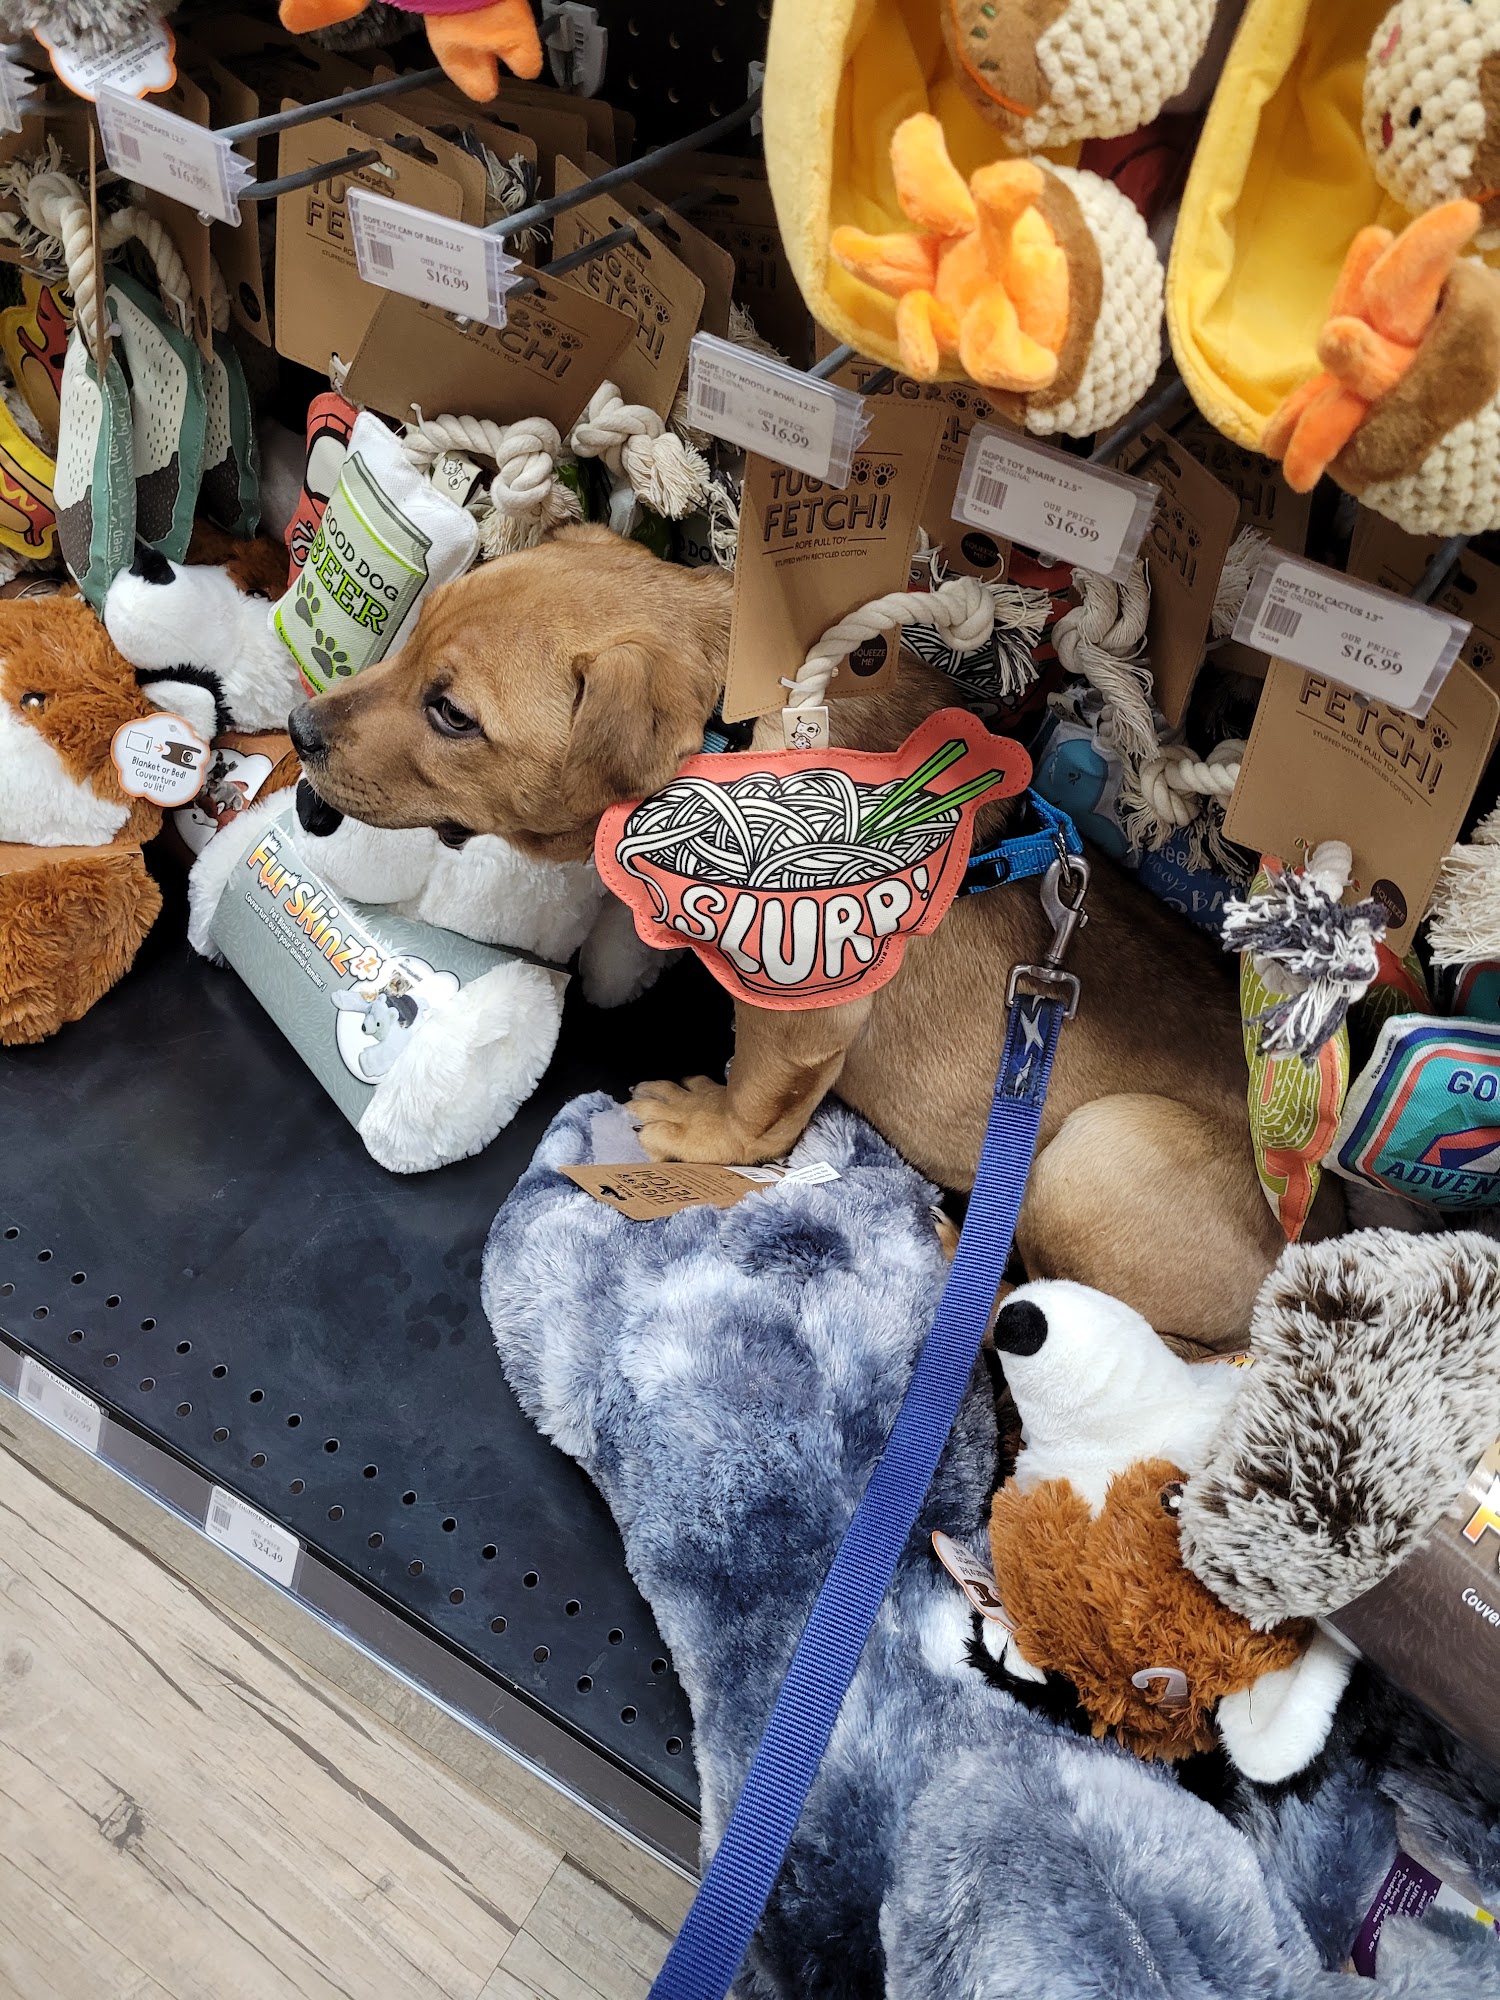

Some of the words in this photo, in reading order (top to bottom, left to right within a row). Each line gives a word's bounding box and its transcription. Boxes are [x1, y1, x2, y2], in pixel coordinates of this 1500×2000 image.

[363, 215, 381, 227] ROPE
[382, 221, 397, 231] TOY
[399, 226, 413, 238] CAN
[415, 232, 424, 240] OF
[425, 235, 444, 247] BEER
[420, 257, 435, 269] OUR
[439, 263, 463, 277] PRICE
[426, 268, 469, 292] $16.99
[503, 353, 520, 365] TOY
[699, 359, 719, 374] ROPE
[722, 368, 737, 379] TOY
[739, 376, 771, 394] NOODLE
[773, 390, 796, 405] BOWL
[758, 408, 774, 420] OUR
[778, 417, 805, 433] PRICE
[761, 420, 809, 449] $16.99
[979, 458, 994, 470] ORE
[996, 464, 1031, 483] ORIGINAL
[981, 450, 1004, 465] ROPE
[1006, 457, 1024, 470] TOY
[1026, 465, 1056, 484] SHARK
[1058, 479, 1083, 492] 12.5"
[763, 494, 891, 541] FETCH!
[1043, 501, 1062, 514] OUR
[1066, 510, 1097, 526] PRICE
[1044, 514, 1100, 542] $16.99
[325, 505, 355, 562] GOOD
[355, 558, 399, 602] DOG
[795, 539, 813, 551] ROPE
[813, 537, 832, 548] PULL
[832, 536, 848, 546] TOY
[796, 555, 811, 565] WITH
[811, 551, 840, 561] RECYCLED
[840, 549, 868, 557] COTTON
[310, 527, 389, 636] BEER
[1272, 586, 1288, 598] ORE
[1290, 592, 1329, 613] ORIGINAL
[1275, 578, 1302, 593] ROPE
[1304, 586, 1324, 600] TOY
[1324, 595, 1364, 616] CACTUS
[1364, 610, 1384, 623] 13"
[1341, 631, 1362, 645] OUR
[1366, 641, 1401, 659] PRICE
[861, 657, 875, 667] ME!
[1341, 644, 1403, 675] $16.99
[1299, 671, 1443, 794] FETCH!
[1313, 729, 1341, 748] STUFFED
[1341, 745, 1359, 760] WITH
[1359, 756, 1389, 783] RECYCLED
[1389, 780, 1414, 805] COTTON
[1341, 731, 1363, 748] ROPE
[1364, 745, 1382, 764] PULL
[1384, 758, 1399, 776] TOY
[132, 756, 161, 773] Blanket
[161, 766, 171, 775] or
[171, 767, 187, 780] Bed!
[135, 768, 177, 787] Couverture
[143, 781, 153, 789] ou
[154, 783, 165, 793] lit!
[269, 906, 280, 920] Pet
[277, 915, 296, 942] Blanket
[293, 937, 302, 946] or
[299, 943, 312, 959] Bed!
[673, 863, 929, 985] SLURP!
[244, 891, 270, 925] Couverture
[267, 920, 275, 931] ou
[273, 926, 282, 938] lit
[278, 932, 292, 952] pour
[289, 947, 306, 969] animal
[304, 962, 324, 989] familier
[1447, 1068, 1498, 1103] GO
[1381, 1161, 1500, 1195] ADVEN
[70, 1389, 81, 1399] BED
[252, 1538, 283, 1564] $24.49
[1461, 1587, 1500, 1628] Couver
[1383, 1869, 1402, 1901] Cuddle
[1388, 1873, 1408, 1906] Perfect
[1397, 1879, 1416, 1913] Squeak
[1406, 1884, 1422, 1909] Ultra
[1372, 1902, 1387, 1923] Time
[1418, 1889, 1428, 1910] and
[1368, 1940, 1375, 1952] or
